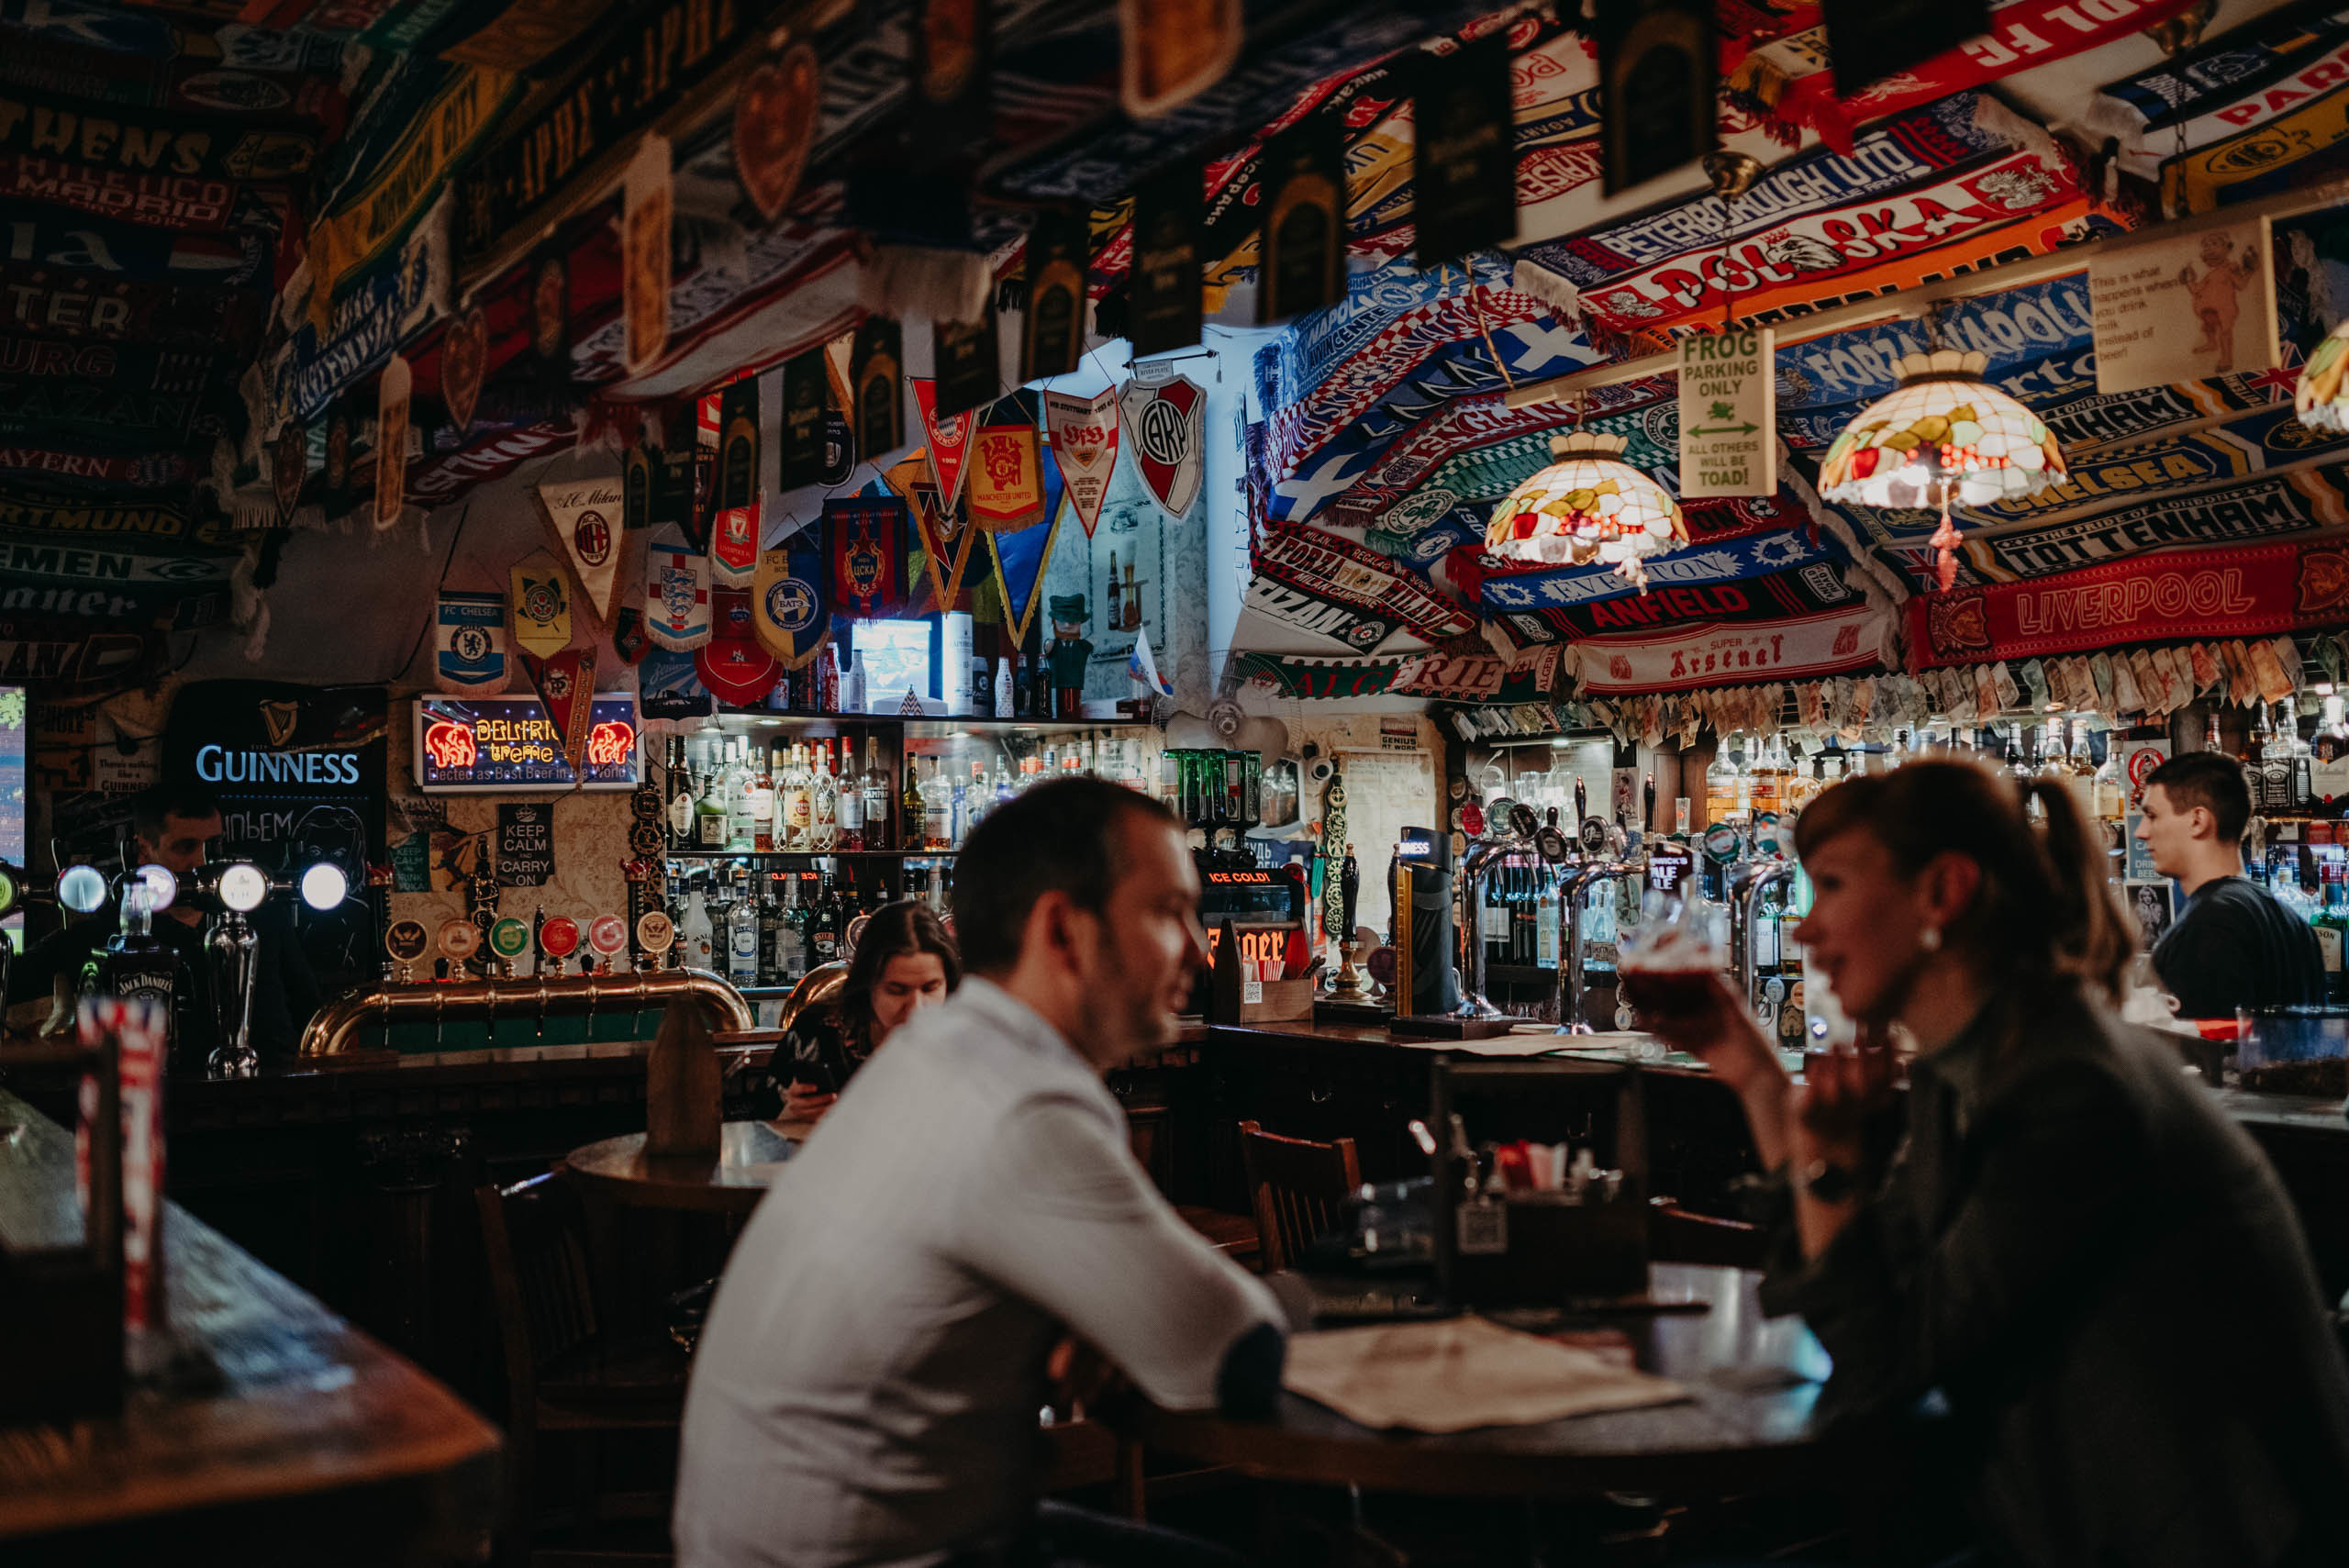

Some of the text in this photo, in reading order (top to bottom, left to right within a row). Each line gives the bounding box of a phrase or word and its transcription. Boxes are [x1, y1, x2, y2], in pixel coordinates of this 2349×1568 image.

[16, 173, 220, 222] MADRID
[1608, 136, 1917, 261] PETERBOROUGH UTD
[1684, 330, 1759, 362] FROG
[1684, 359, 1758, 381] PARKING
[1699, 379, 1742, 397] ONLY
[2048, 390, 2202, 444] NHAM
[1688, 439, 1759, 456] ALL OTHERS
[1700, 454, 1746, 468] WILL BE
[1698, 467, 1750, 487] TOAD!
[1998, 451, 2210, 516] CHELSEA
[588, 488, 622, 505] Milan
[1012, 492, 1032, 500] UNITED
[2075, 515, 2127, 535] PRIDE
[2131, 507, 2153, 520] OF
[2157, 492, 2237, 511] LONDON
[2003, 486, 2296, 569] TOTTENHAM
[765, 555, 778, 565] FC
[1283, 535, 1346, 587] FORZA
[853, 565, 874, 576] ЦСКА
[1551, 559, 1727, 606] EVETON
[444, 606, 498, 617] FC CHELSEA
[779, 599, 804, 609] БАТЭ
[1586, 584, 1751, 629] ANFIELD
[2018, 568, 2257, 637] LIVERPOOL
[1709, 637, 1742, 650] SUPER
[1669, 631, 1785, 679] Arsenal
[1294, 651, 1497, 697] ALGERIE
[1537, 644, 1559, 691] ALGERIE
[1382, 737, 1417, 745] GENIUS
[490, 742, 554, 762] treme
[195, 744, 360, 784] GUINNESS
[428, 765, 627, 781] Elected as Best Beer in te World
[102, 780, 153, 792] GUINNES
[506, 825, 544, 837] KEEP
[504, 839, 547, 851] CALM
[501, 861, 550, 873] CARRY
[515, 874, 537, 886] ON
[1208, 872, 1271, 884] ICE COLD!
[118, 978, 140, 995] JACK
